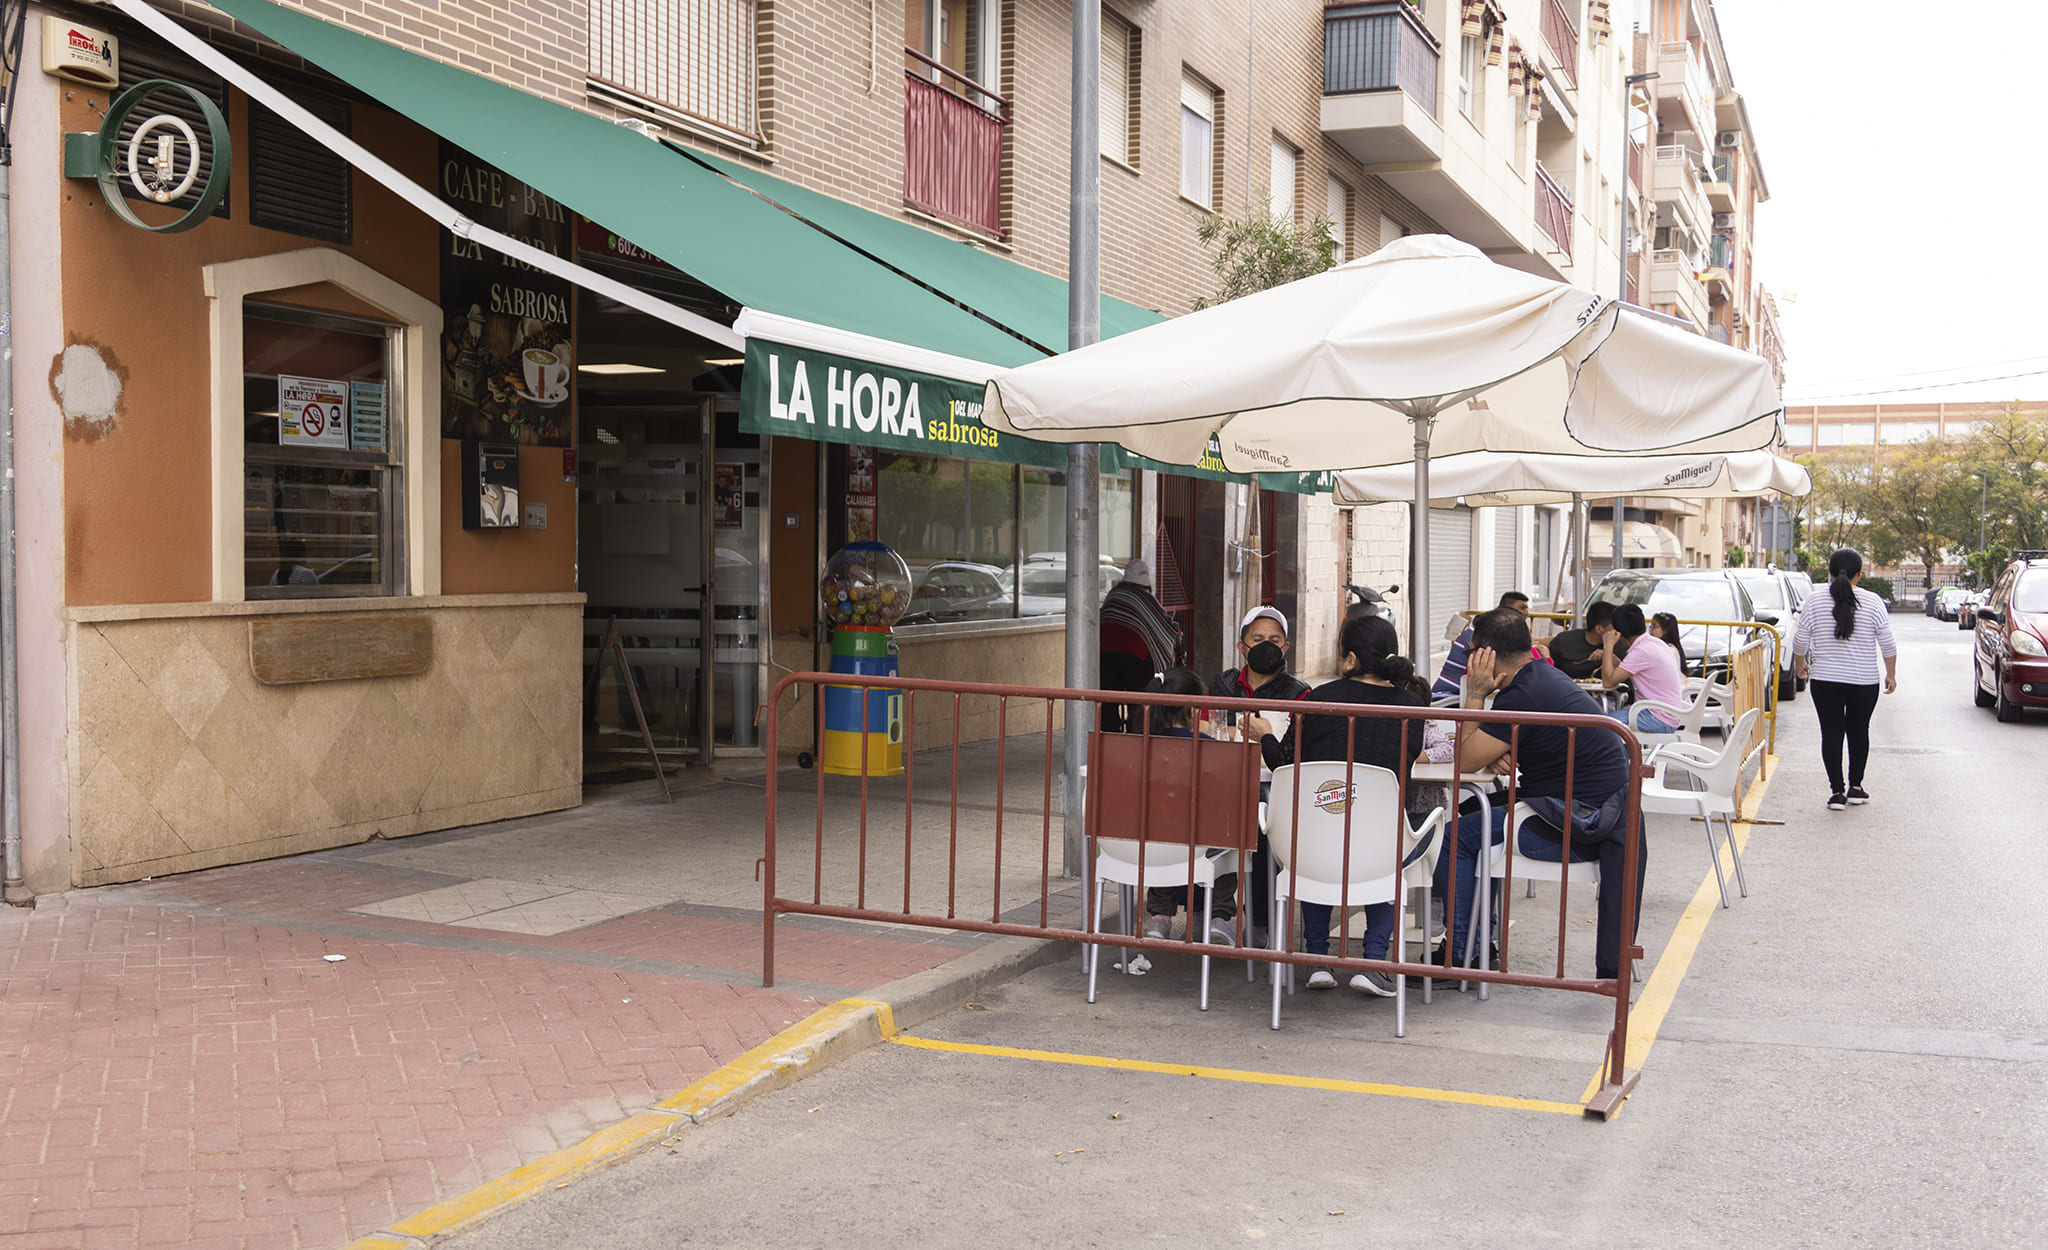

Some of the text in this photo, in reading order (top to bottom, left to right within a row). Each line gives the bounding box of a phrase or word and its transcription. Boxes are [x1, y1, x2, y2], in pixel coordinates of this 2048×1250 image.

[444, 159, 504, 208] CAFE
[523, 184, 565, 224] BAR
[490, 282, 568, 324] SABROSA
[285, 390, 294, 400] LA
[296, 392, 317, 401] HORA
[769, 354, 924, 439] LA HORA
[955, 399, 967, 416] DEL
[928, 400, 999, 448] sabrosa
[1663, 461, 1712, 486] SanMiguel
[845, 494, 876, 507] CALAMARES
[1314, 787, 1356, 804] SanMigl
